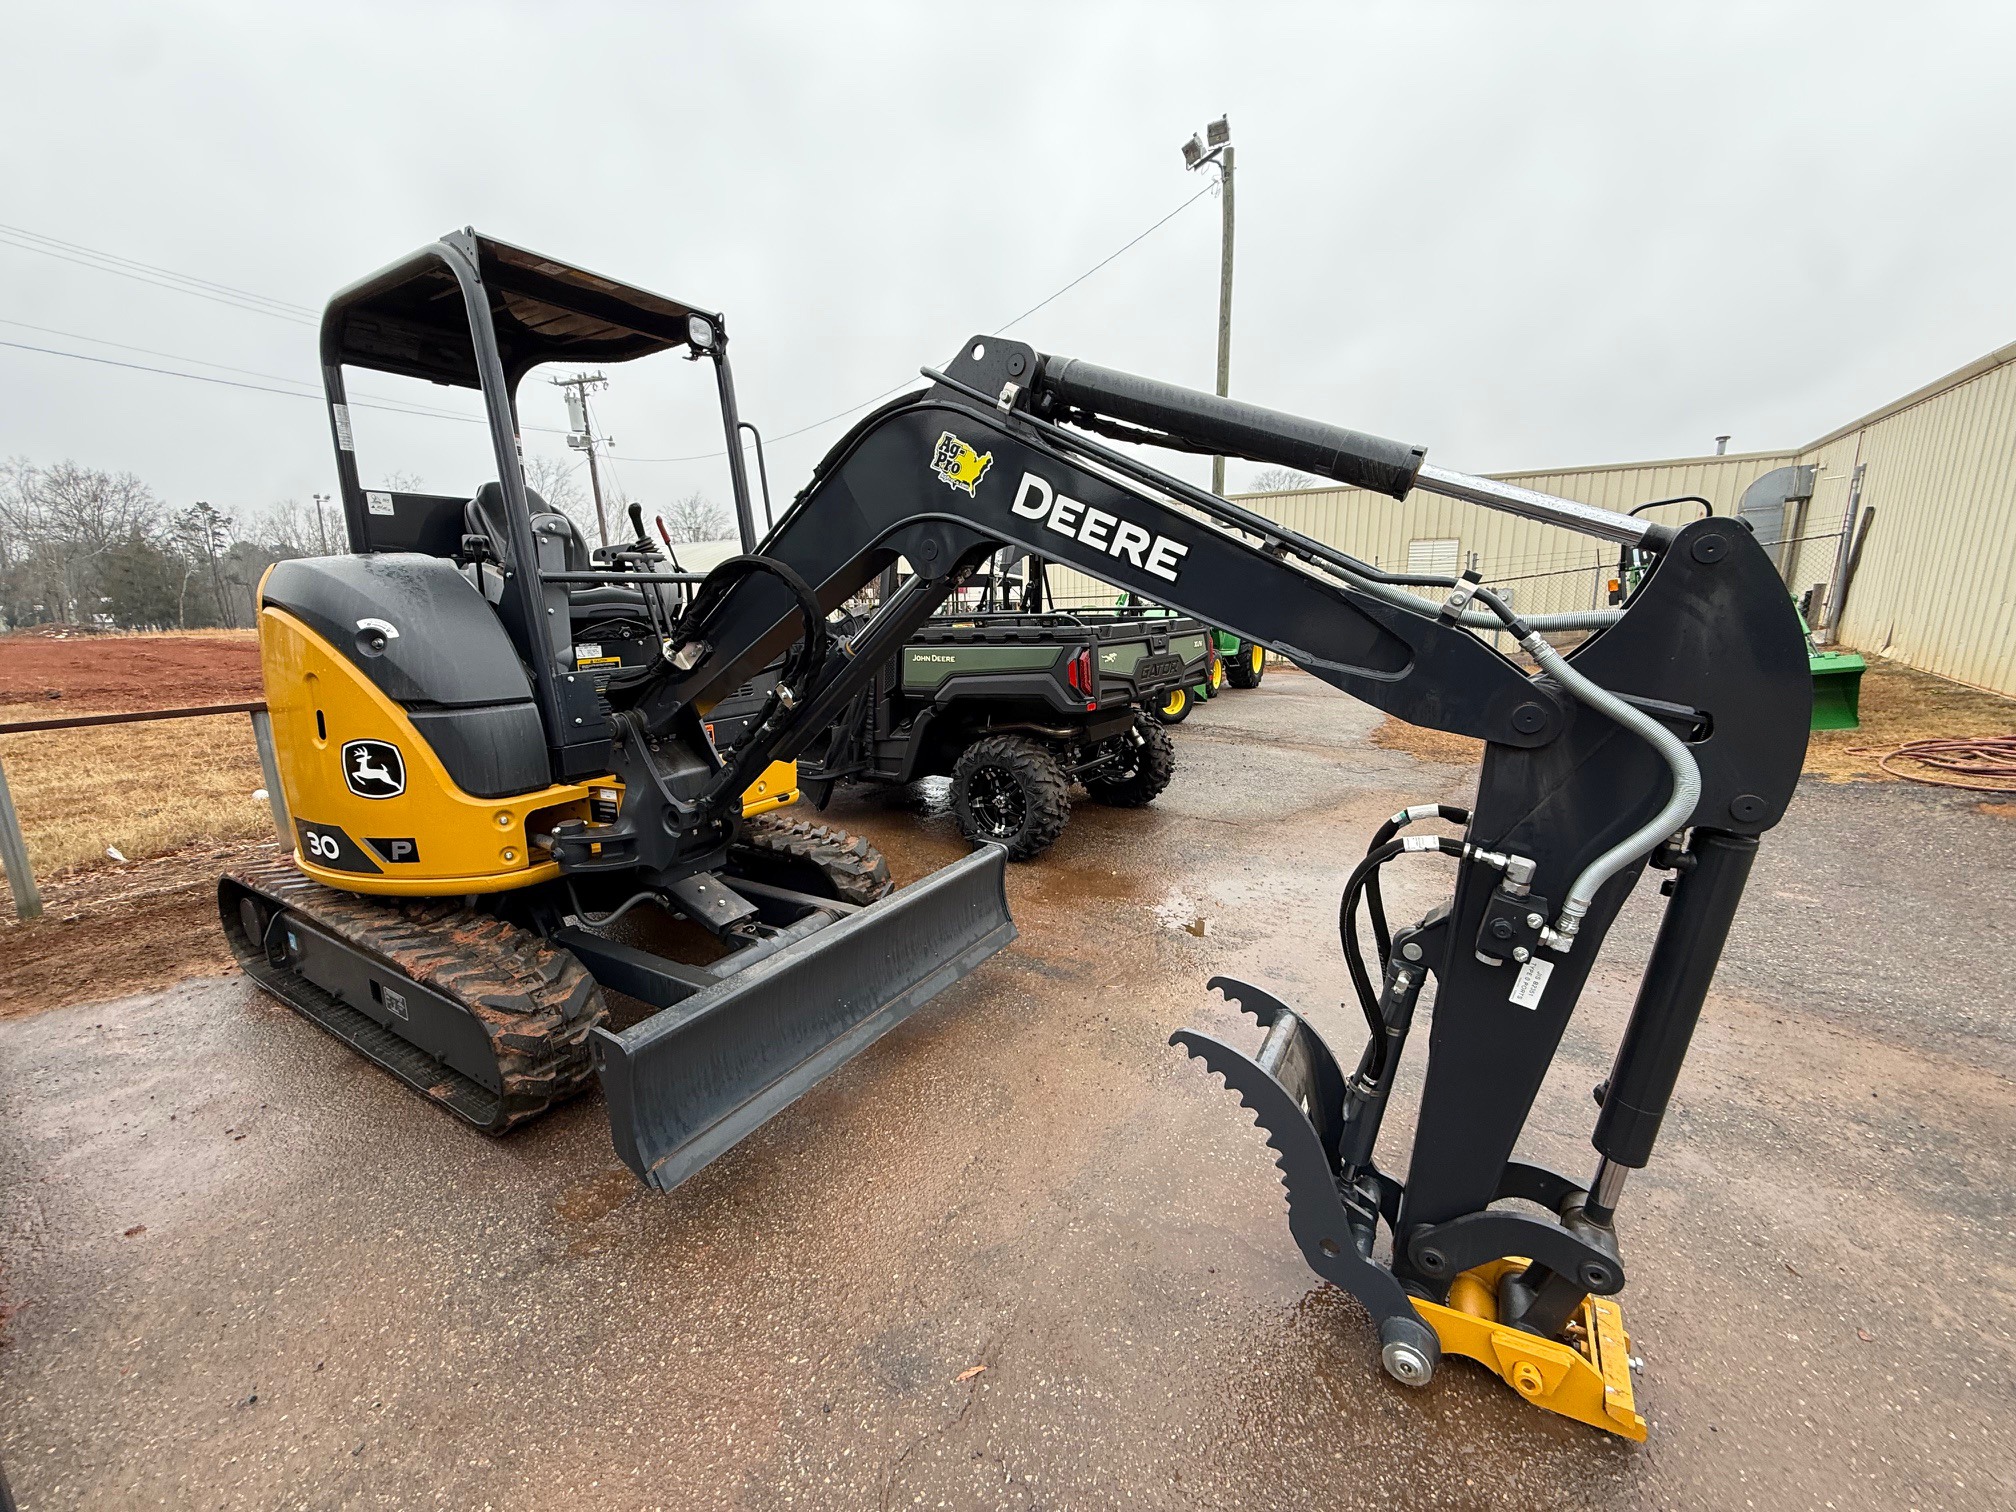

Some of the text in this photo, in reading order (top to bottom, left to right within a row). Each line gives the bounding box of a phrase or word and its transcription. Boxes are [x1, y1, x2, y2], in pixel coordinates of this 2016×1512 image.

[934, 450, 961, 474] Pro
[1011, 471, 1189, 582] DEERE
[1141, 660, 1179, 678] GATOR
[306, 831, 340, 860] 30
[391, 841, 412, 860] P
[1526, 962, 1537, 976] TYPE
[1516, 981, 1529, 999] PORTS
